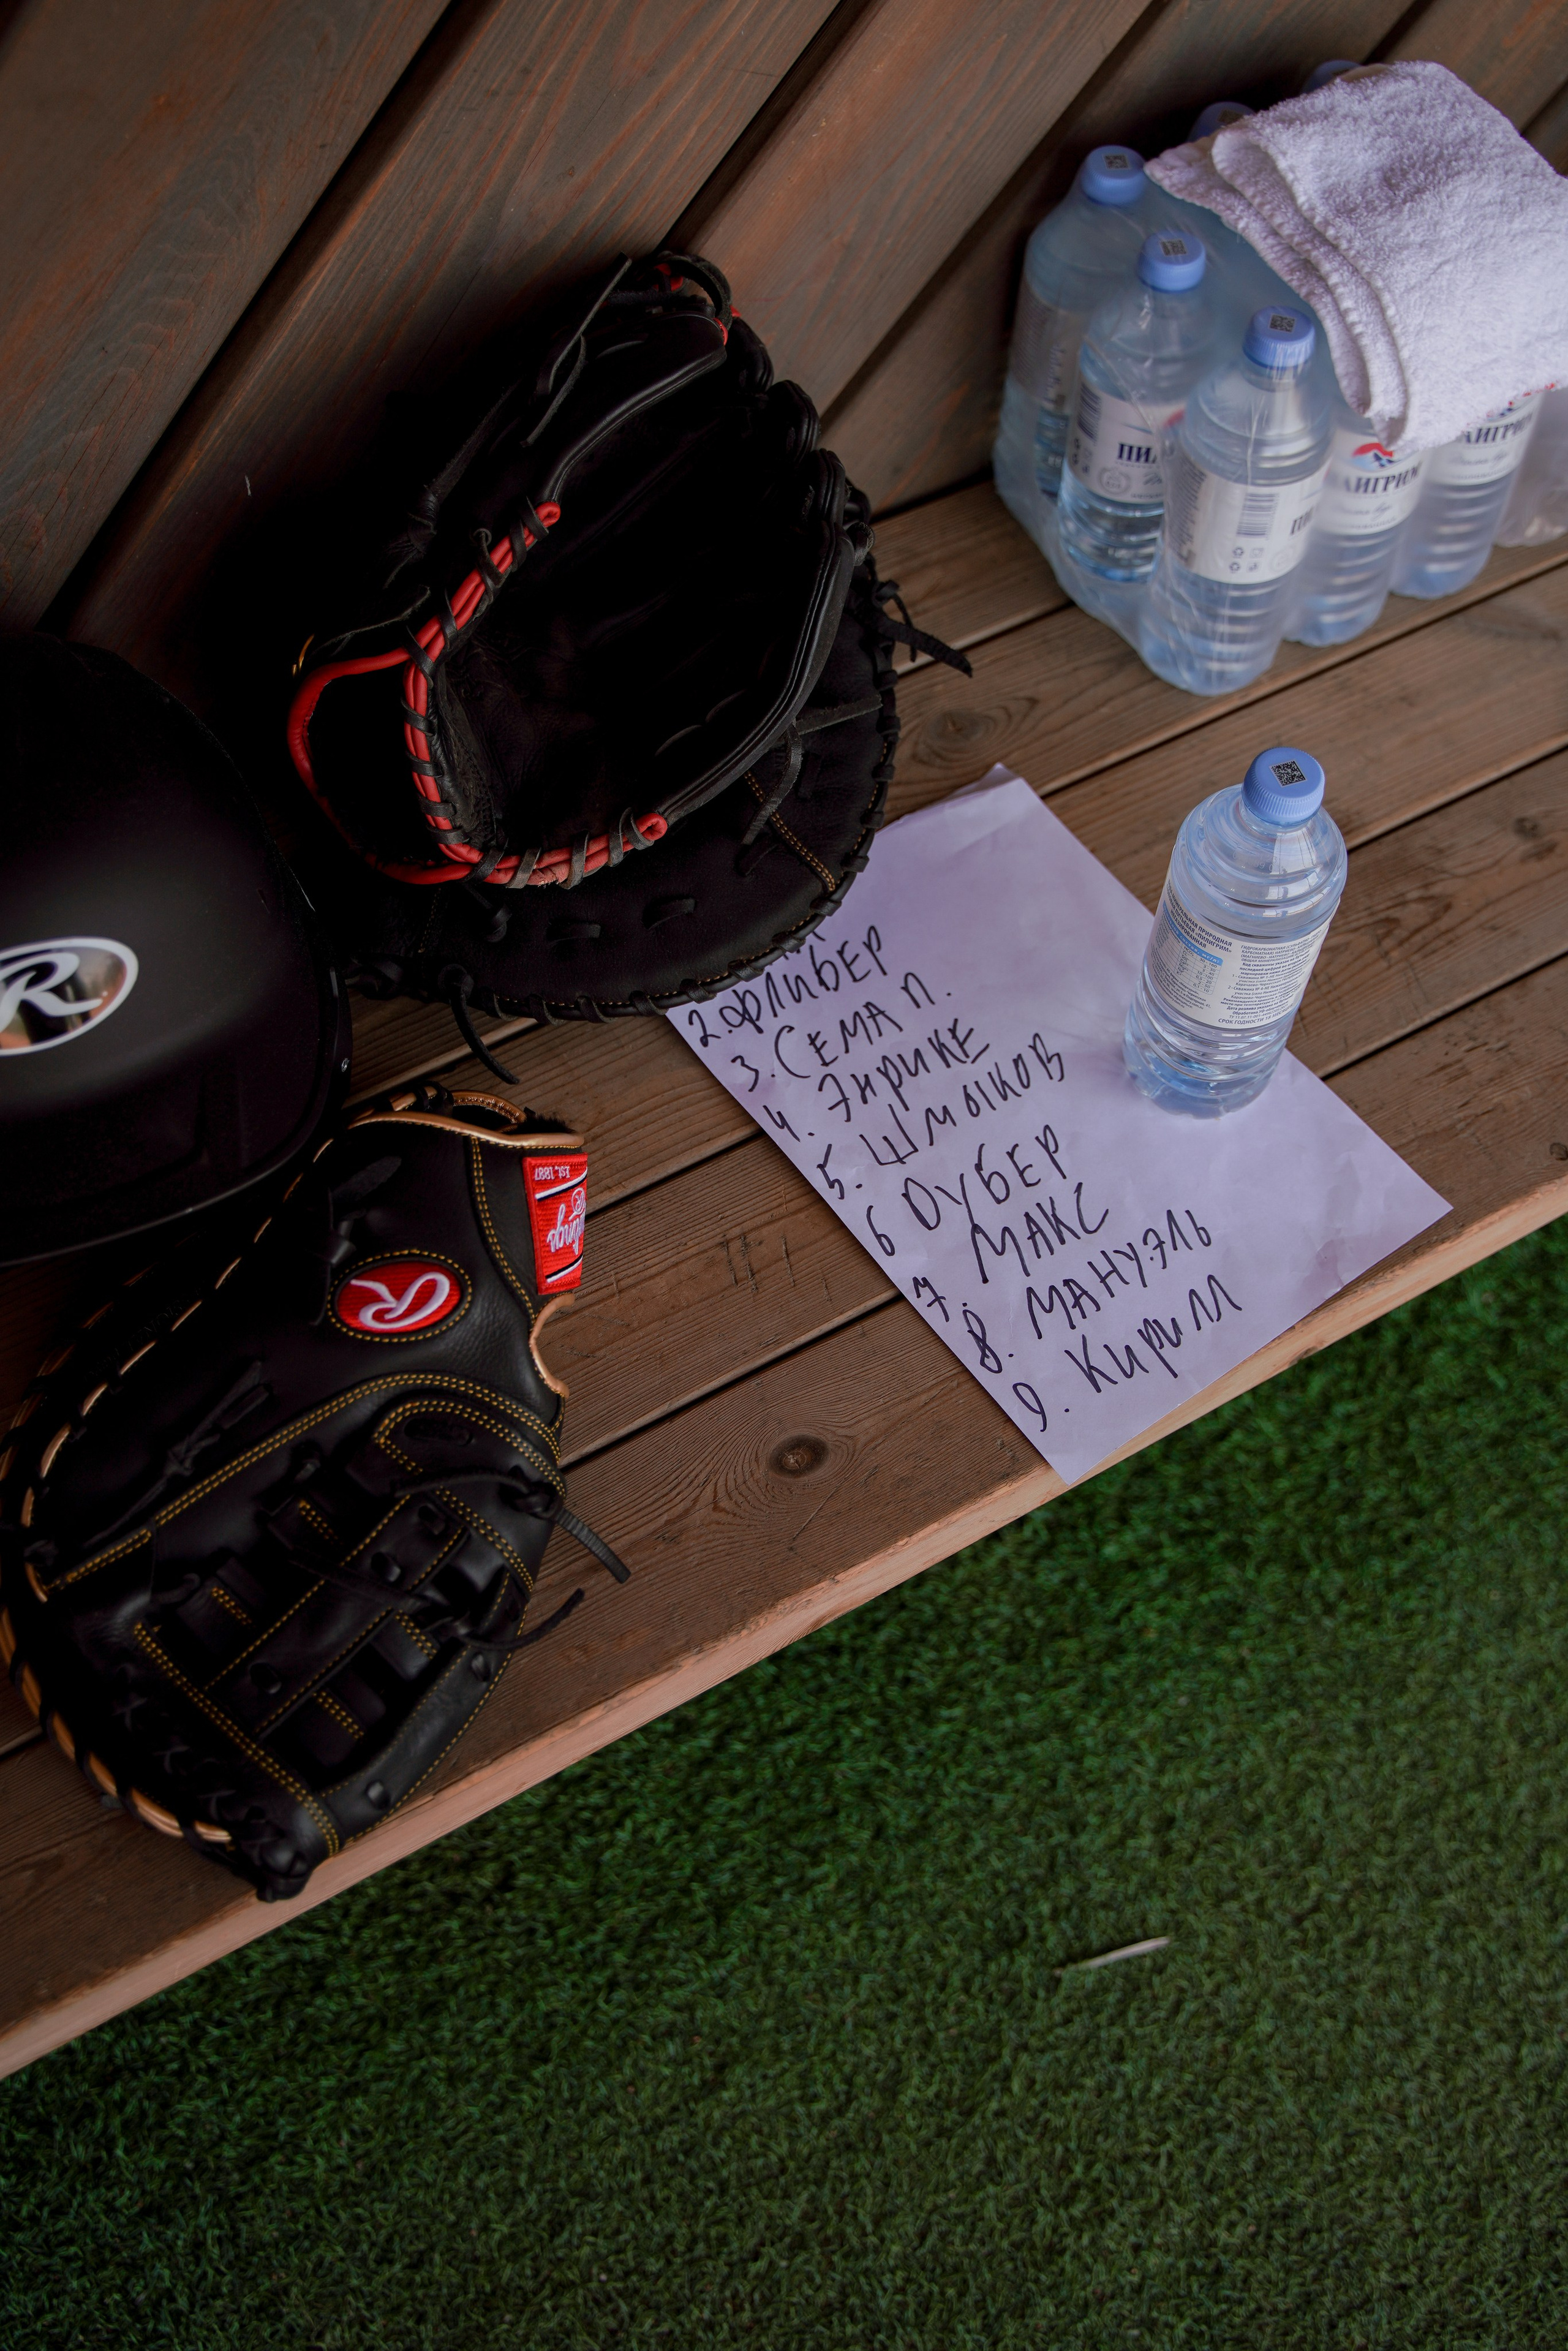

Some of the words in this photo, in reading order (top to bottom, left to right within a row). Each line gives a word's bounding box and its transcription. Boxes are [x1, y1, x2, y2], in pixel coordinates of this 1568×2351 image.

[1171, 909, 1207, 948] НЕГАЗИРОВАННАЯ
[1195, 932, 1232, 953] «ПИЛИГРИМ»
[1198, 926, 1232, 947] ПРИРОДНАЯ
[866, 1205, 895, 1256] 6
[350, 1270, 451, 1329] R
